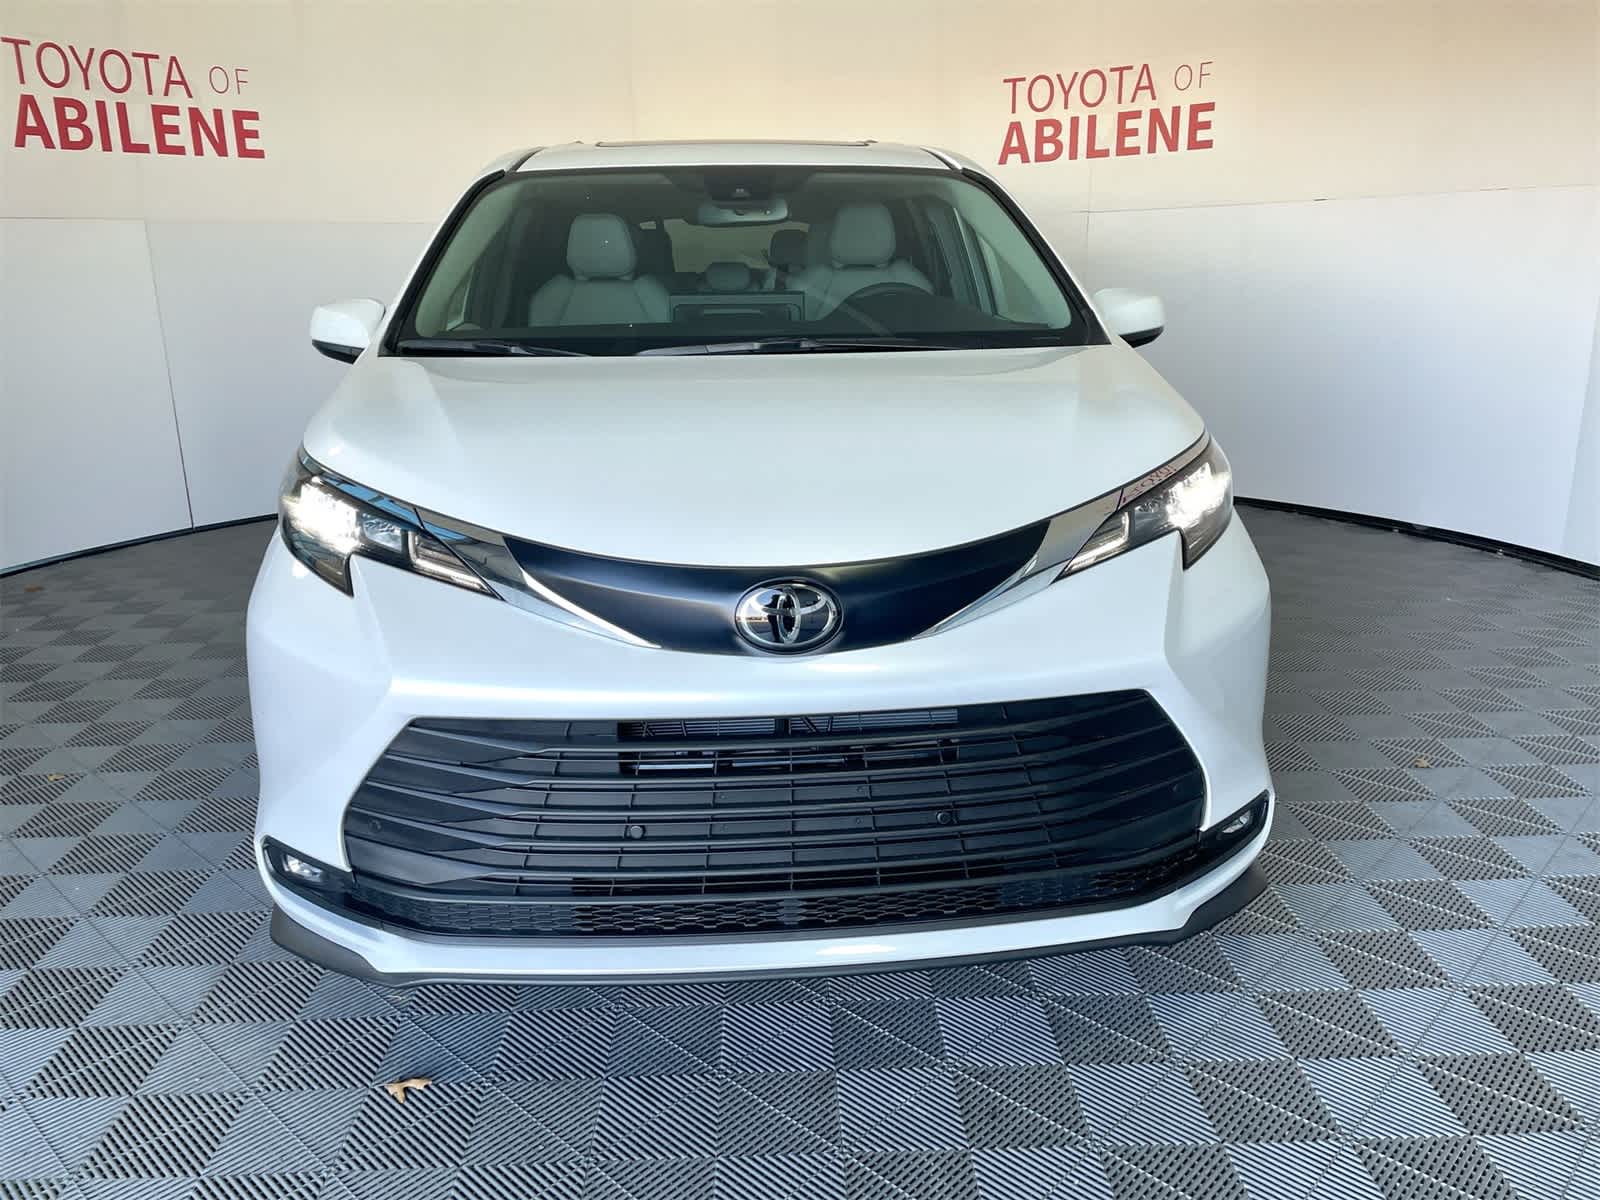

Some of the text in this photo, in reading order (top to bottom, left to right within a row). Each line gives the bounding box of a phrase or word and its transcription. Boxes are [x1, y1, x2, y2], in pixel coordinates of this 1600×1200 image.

[0, 36, 249, 99] TOYOTA OF
[1003, 61, 1214, 114] TOYOTA OF
[14, 93, 266, 159] ABILENE
[998, 101, 1216, 165] ABILENE
